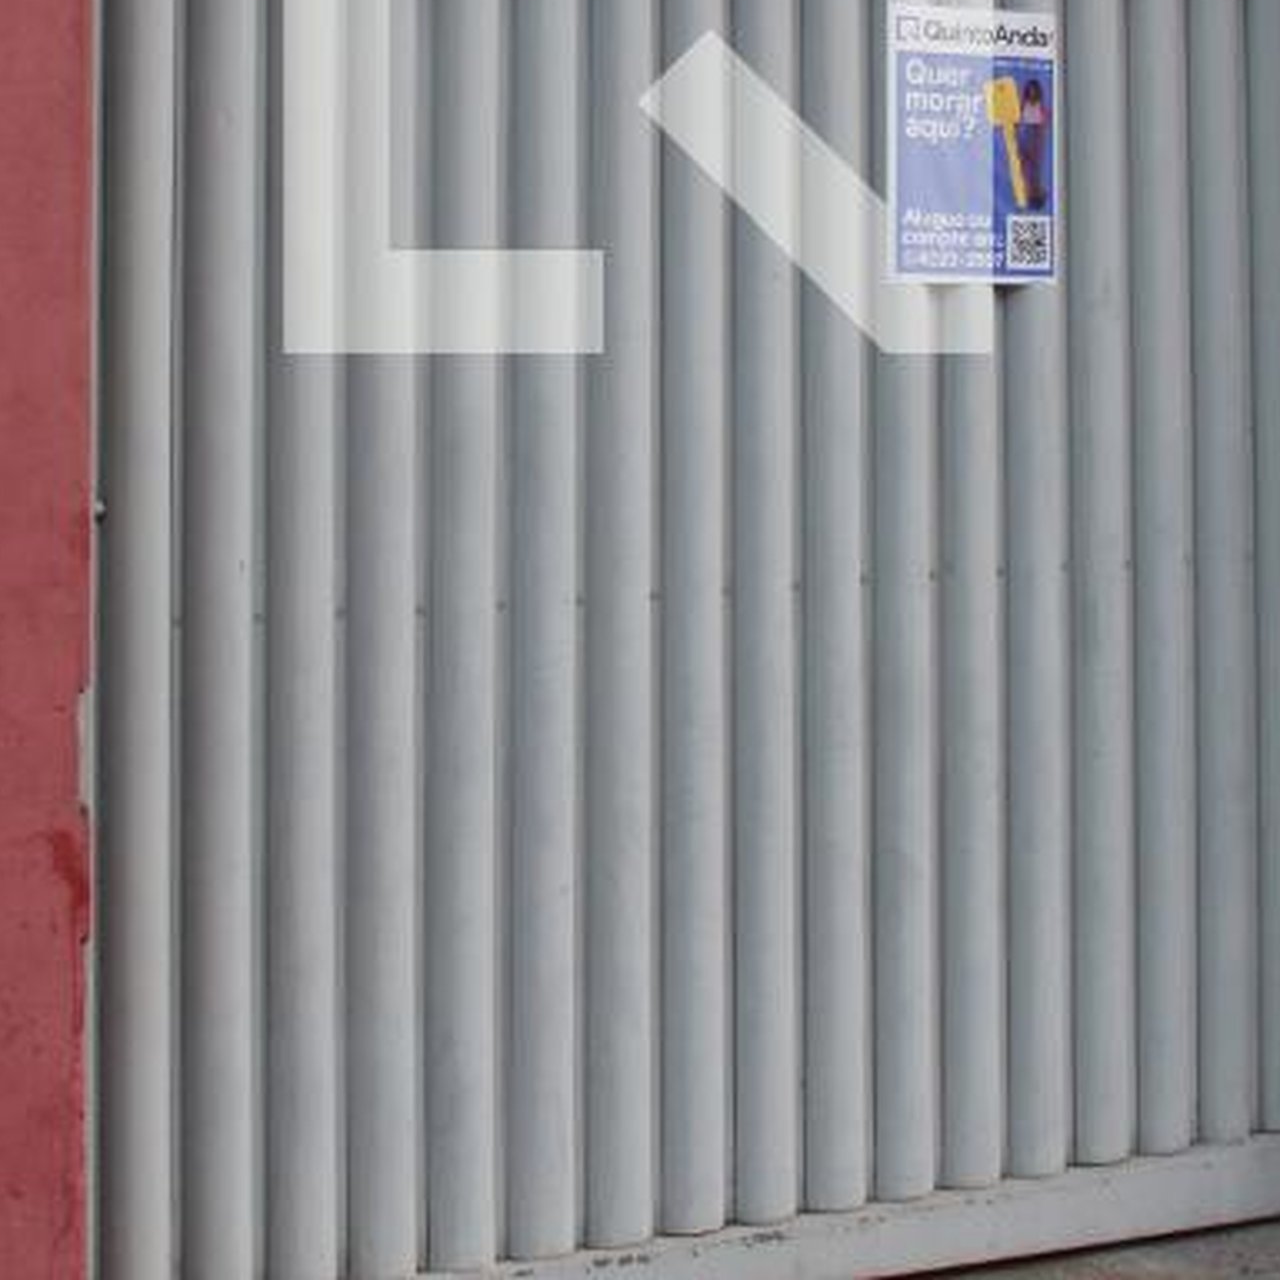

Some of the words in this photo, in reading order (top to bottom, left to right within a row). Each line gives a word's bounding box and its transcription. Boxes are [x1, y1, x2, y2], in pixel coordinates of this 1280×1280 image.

[905, 58, 972, 86] Quer
[905, 91, 982, 114] morar
[905, 116, 976, 144] aqui?
